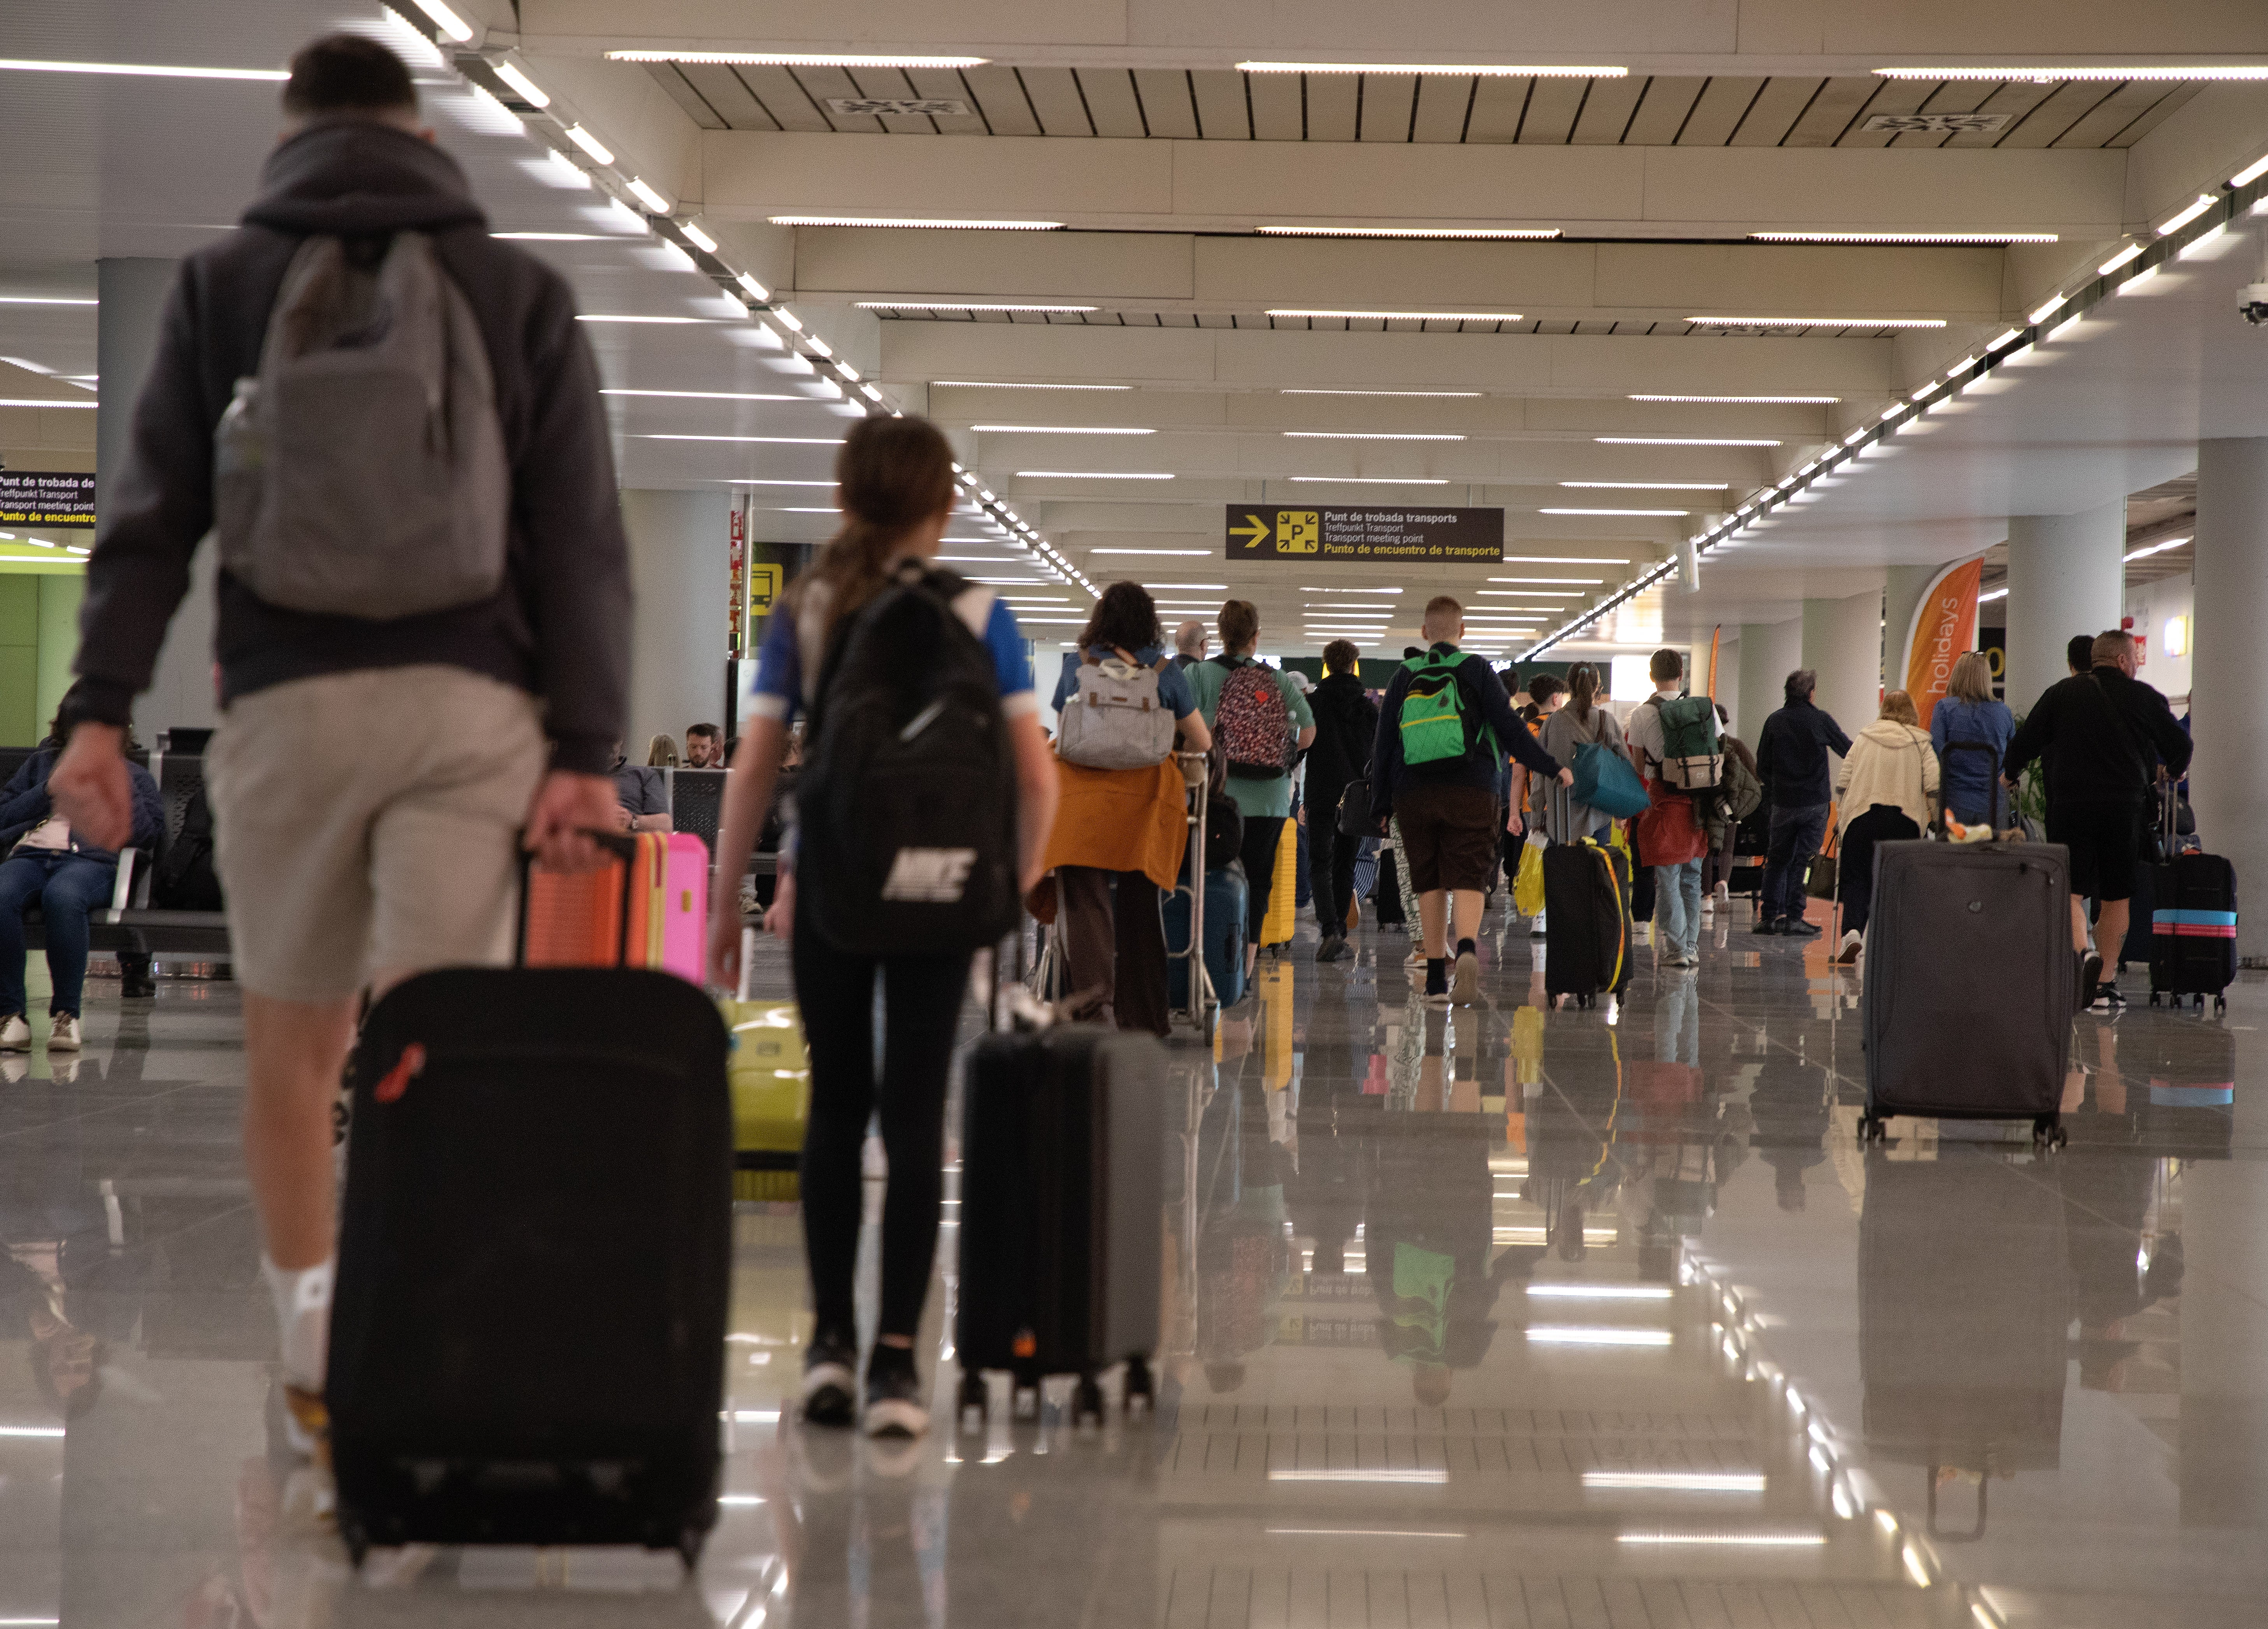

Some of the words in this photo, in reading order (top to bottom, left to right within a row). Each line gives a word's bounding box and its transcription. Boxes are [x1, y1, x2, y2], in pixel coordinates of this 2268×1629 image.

[22, 477, 36, 486] de
[39, 477, 79, 487] trobada
[81, 478, 95, 488] de
[39, 489, 78, 500] Transport
[0, 500, 36, 510] ransport
[38, 501, 71, 512] meeting
[73, 502, 94, 512] point
[28, 511, 42, 521] de
[45, 514, 96, 522] encuentro
[1324, 511, 1347, 521] Punt
[1350, 511, 1363, 521] de
[1365, 512, 1403, 522] trobada
[1406, 513, 1457, 524] transports
[1291, 525, 1303, 540] P
[1325, 522, 1363, 532] Treffpunkt
[1366, 523, 1404, 534] Transport
[1325, 532, 1364, 543] Transport
[1366, 533, 1400, 544] meeting
[1403, 534, 1424, 544] point
[1324, 543, 1354, 554] Punto
[1357, 544, 1370, 554] de
[1374, 545, 1426, 555] encuentro
[1429, 545, 1443, 555] de
[1445, 546, 1500, 558] transporte
[1927, 597, 1959, 693] holidays
